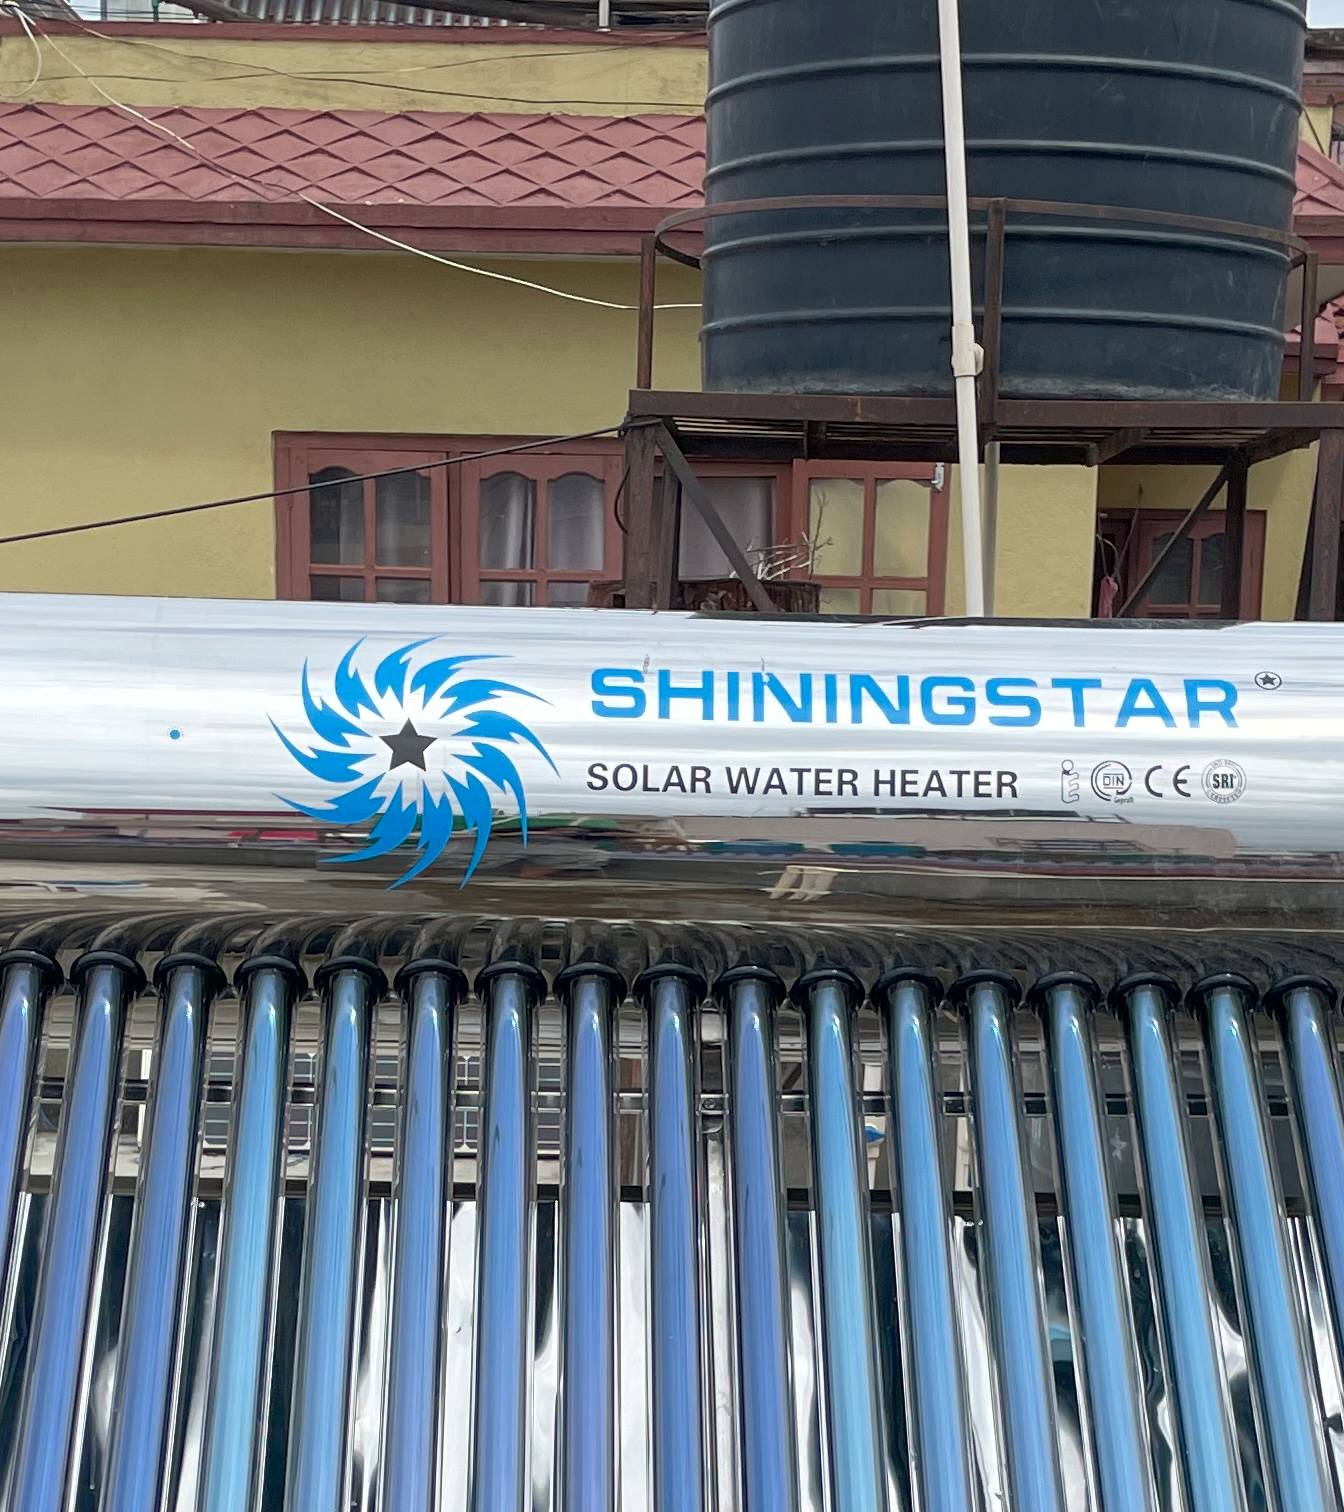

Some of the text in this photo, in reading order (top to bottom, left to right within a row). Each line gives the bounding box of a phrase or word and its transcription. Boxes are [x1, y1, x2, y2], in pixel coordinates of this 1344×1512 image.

[591, 668, 1239, 729] SHININGSTAR
[586, 762, 1018, 799] SOLAR WATER HEATER
[1102, 774, 1125, 787] DIN
[1144, 764, 1192, 798] CE
[1212, 773, 1234, 789] SRI
